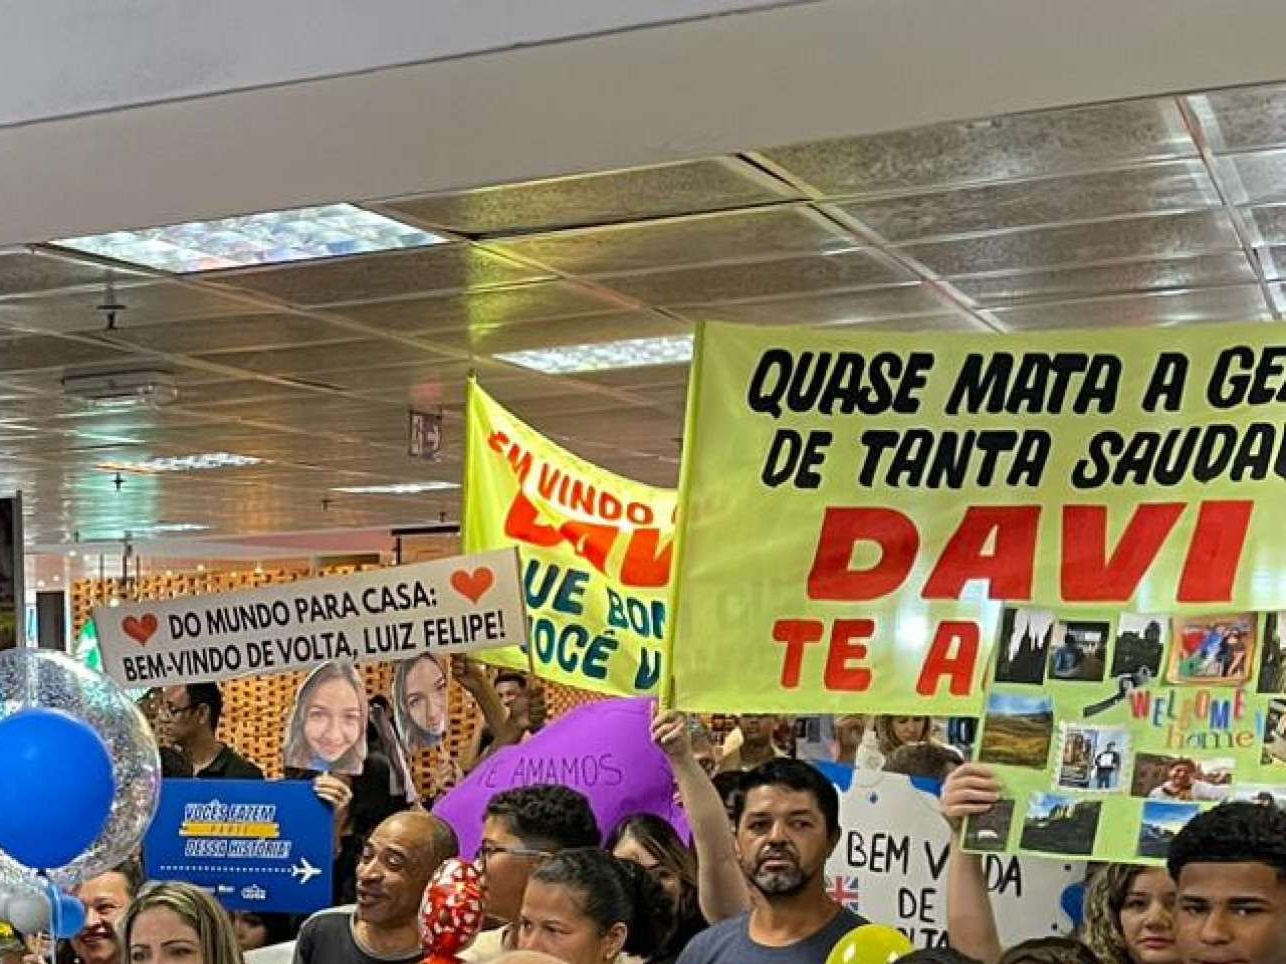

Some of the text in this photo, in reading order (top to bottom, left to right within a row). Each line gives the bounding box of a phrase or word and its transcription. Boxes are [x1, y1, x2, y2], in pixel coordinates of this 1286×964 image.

[748, 345, 1286, 418] QUASE MATA A GE
[762, 430, 833, 488] DE
[859, 430, 1052, 488] TANTA
[539, 463, 654, 524] VINDO
[806, 500, 1255, 603] DAVI
[169, 580, 438, 640] DO MUNDO PARA CASA:
[524, 559, 589, 615] UE
[122, 610, 506, 683] BEM-VINDO DE VOLTA, LUIZ FELIPE!
[528, 617, 619, 680] OCÊ
[773, 618, 988, 696] TE A
[1166, 725, 1255, 749] home
[510, 752, 623, 787] AMAMOS
[847, 831, 1022, 897] BEM VDA
[898, 887, 937, 922] DE
